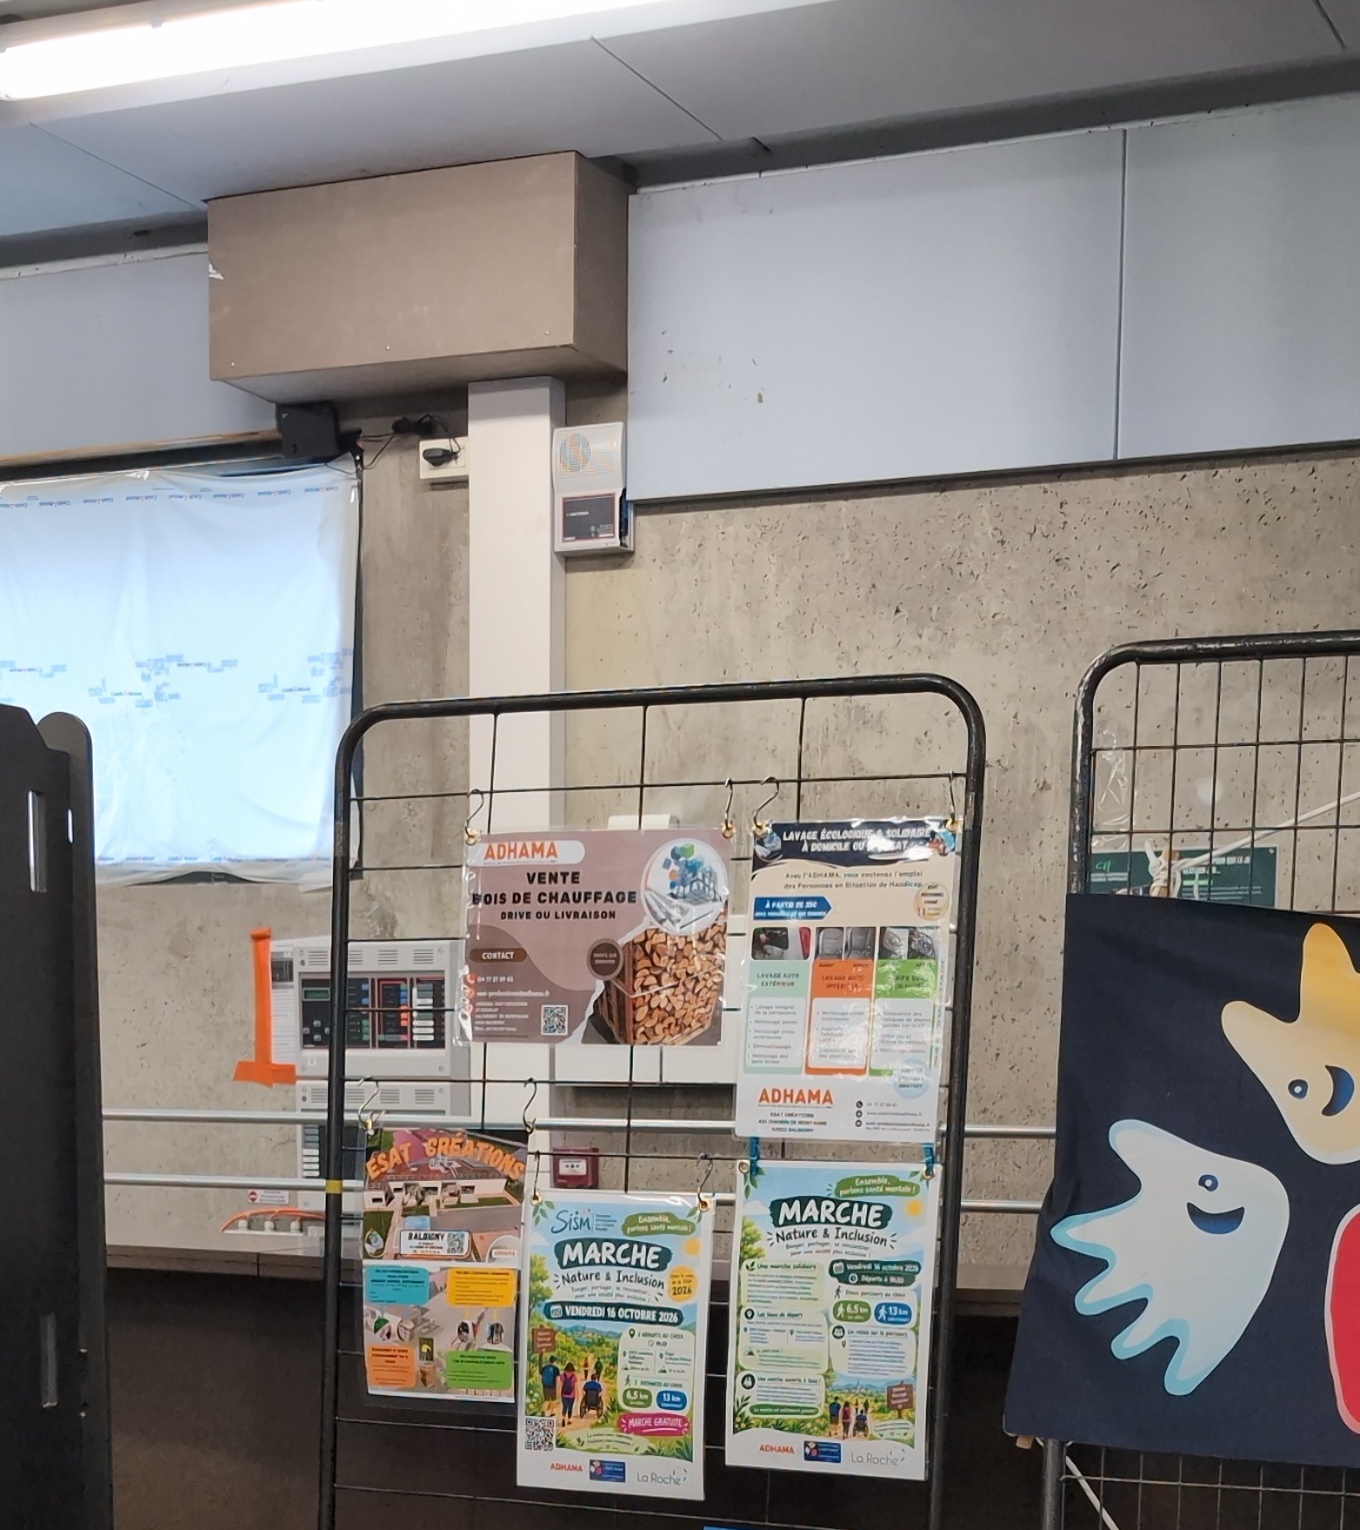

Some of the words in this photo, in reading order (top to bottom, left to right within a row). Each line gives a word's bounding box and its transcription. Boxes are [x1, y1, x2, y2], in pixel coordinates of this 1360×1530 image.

[783, 830, 818, 841] LAVAGE
[484, 841, 558, 861] ADHAMA
[526, 871, 580, 885] VENTE
[472, 892, 507, 906] BOIS
[512, 892, 531, 905] DE
[537, 891, 637, 904] CHAUFFAGE
[500, 911, 531, 920] DRIVE
[536, 911, 550, 920] OU
[554, 910, 616, 920] LIVRAISON
[482, 951, 514, 960] CONTACT
[759, 1088, 833, 1105] ADHAMA
[366, 1142, 412, 1181] ESAT
[426, 1132, 526, 1181] CRÉATIONS
[779, 1200, 884, 1227] MARCHE
[776, 1228, 817, 1242] Nature
[823, 1228, 830, 1238] &
[834, 1227, 888, 1247] Inclusion
[563, 1241, 662, 1268] MARCHE
[562, 1271, 601, 1285] Nature
[605, 1272, 610, 1281] &
[616, 1270, 665, 1290] Inclusion
[672, 1286, 692, 1296] 2026
[565, 1305, 605, 1318] VENDREDI
[607, 1307, 615, 1318] 16
[618, 1308, 656, 1320] OCTOBRE
[659, 1311, 678, 1323] 2026
[759, 1444, 794, 1454] ADHAMA
[852, 1452, 863, 1463] La
[867, 1452, 898, 1466] Roche
[651, 1473, 681, 1485] Roche
